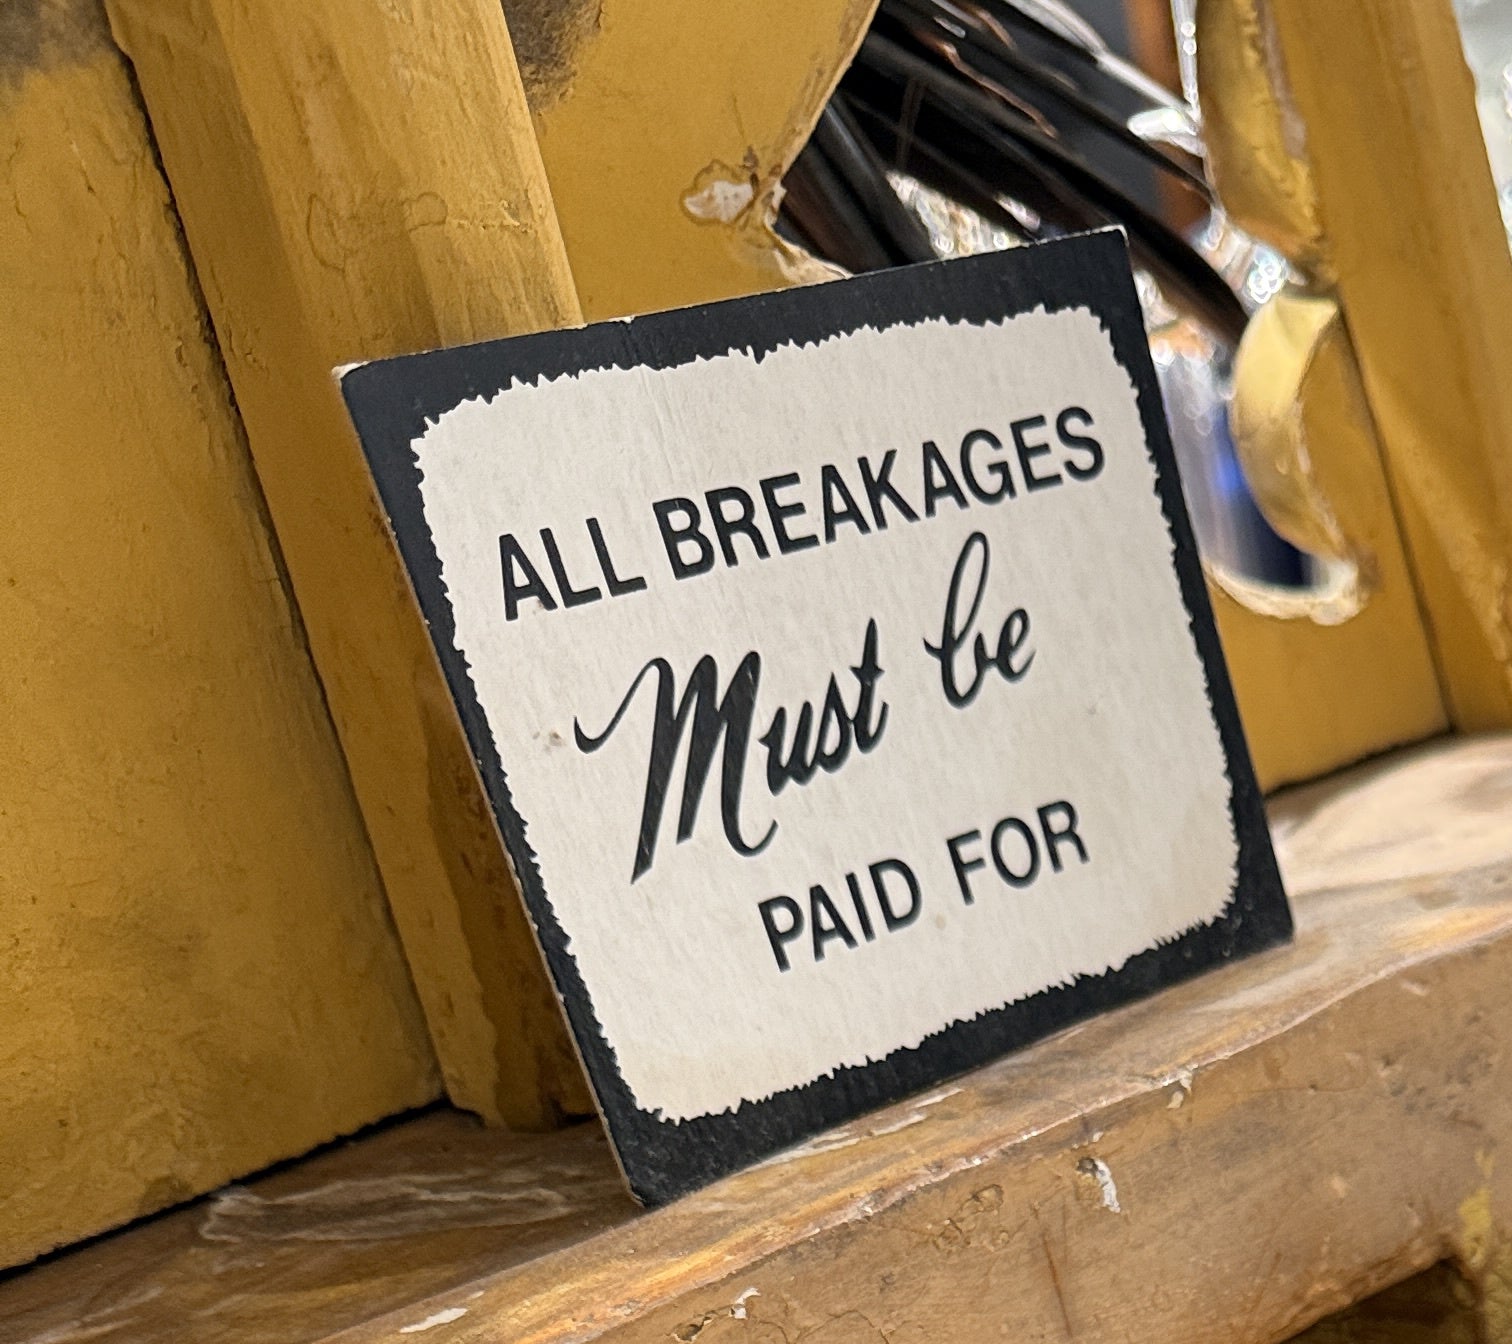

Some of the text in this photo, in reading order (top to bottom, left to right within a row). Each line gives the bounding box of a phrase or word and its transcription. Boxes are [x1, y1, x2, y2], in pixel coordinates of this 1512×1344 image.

[497, 405, 1106, 622] ALL BREAKAGES
[573, 531, 1035, 884] Must be
[757, 799, 1091, 972] PAID FOR
